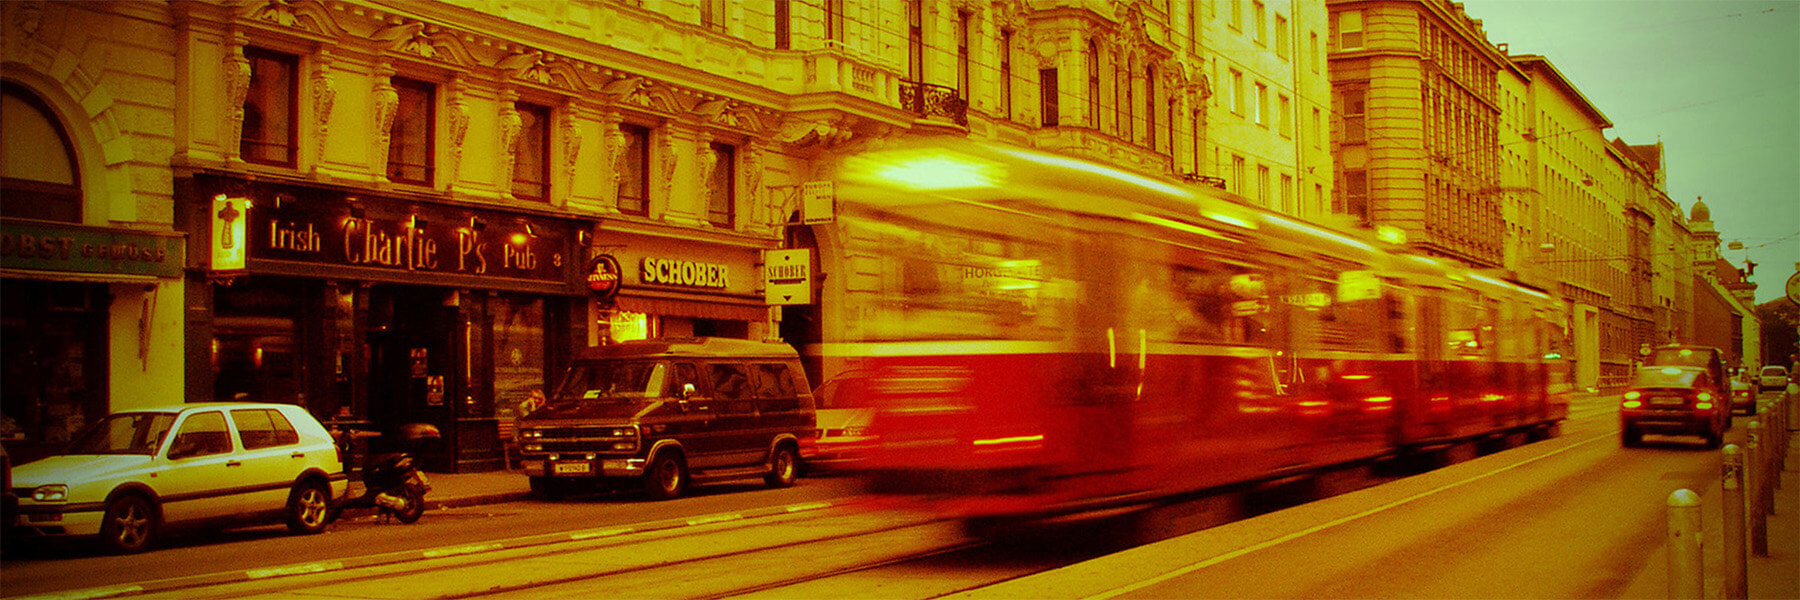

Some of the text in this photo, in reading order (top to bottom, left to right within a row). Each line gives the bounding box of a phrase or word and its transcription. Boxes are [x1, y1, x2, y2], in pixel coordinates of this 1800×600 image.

[270, 219, 321, 252] Irish
[344, 216, 438, 271] Charlie
[503, 243, 537, 270] Pub
[642, 256, 730, 289] SCHOBER
[767, 264, 807, 280] SCHOBER
